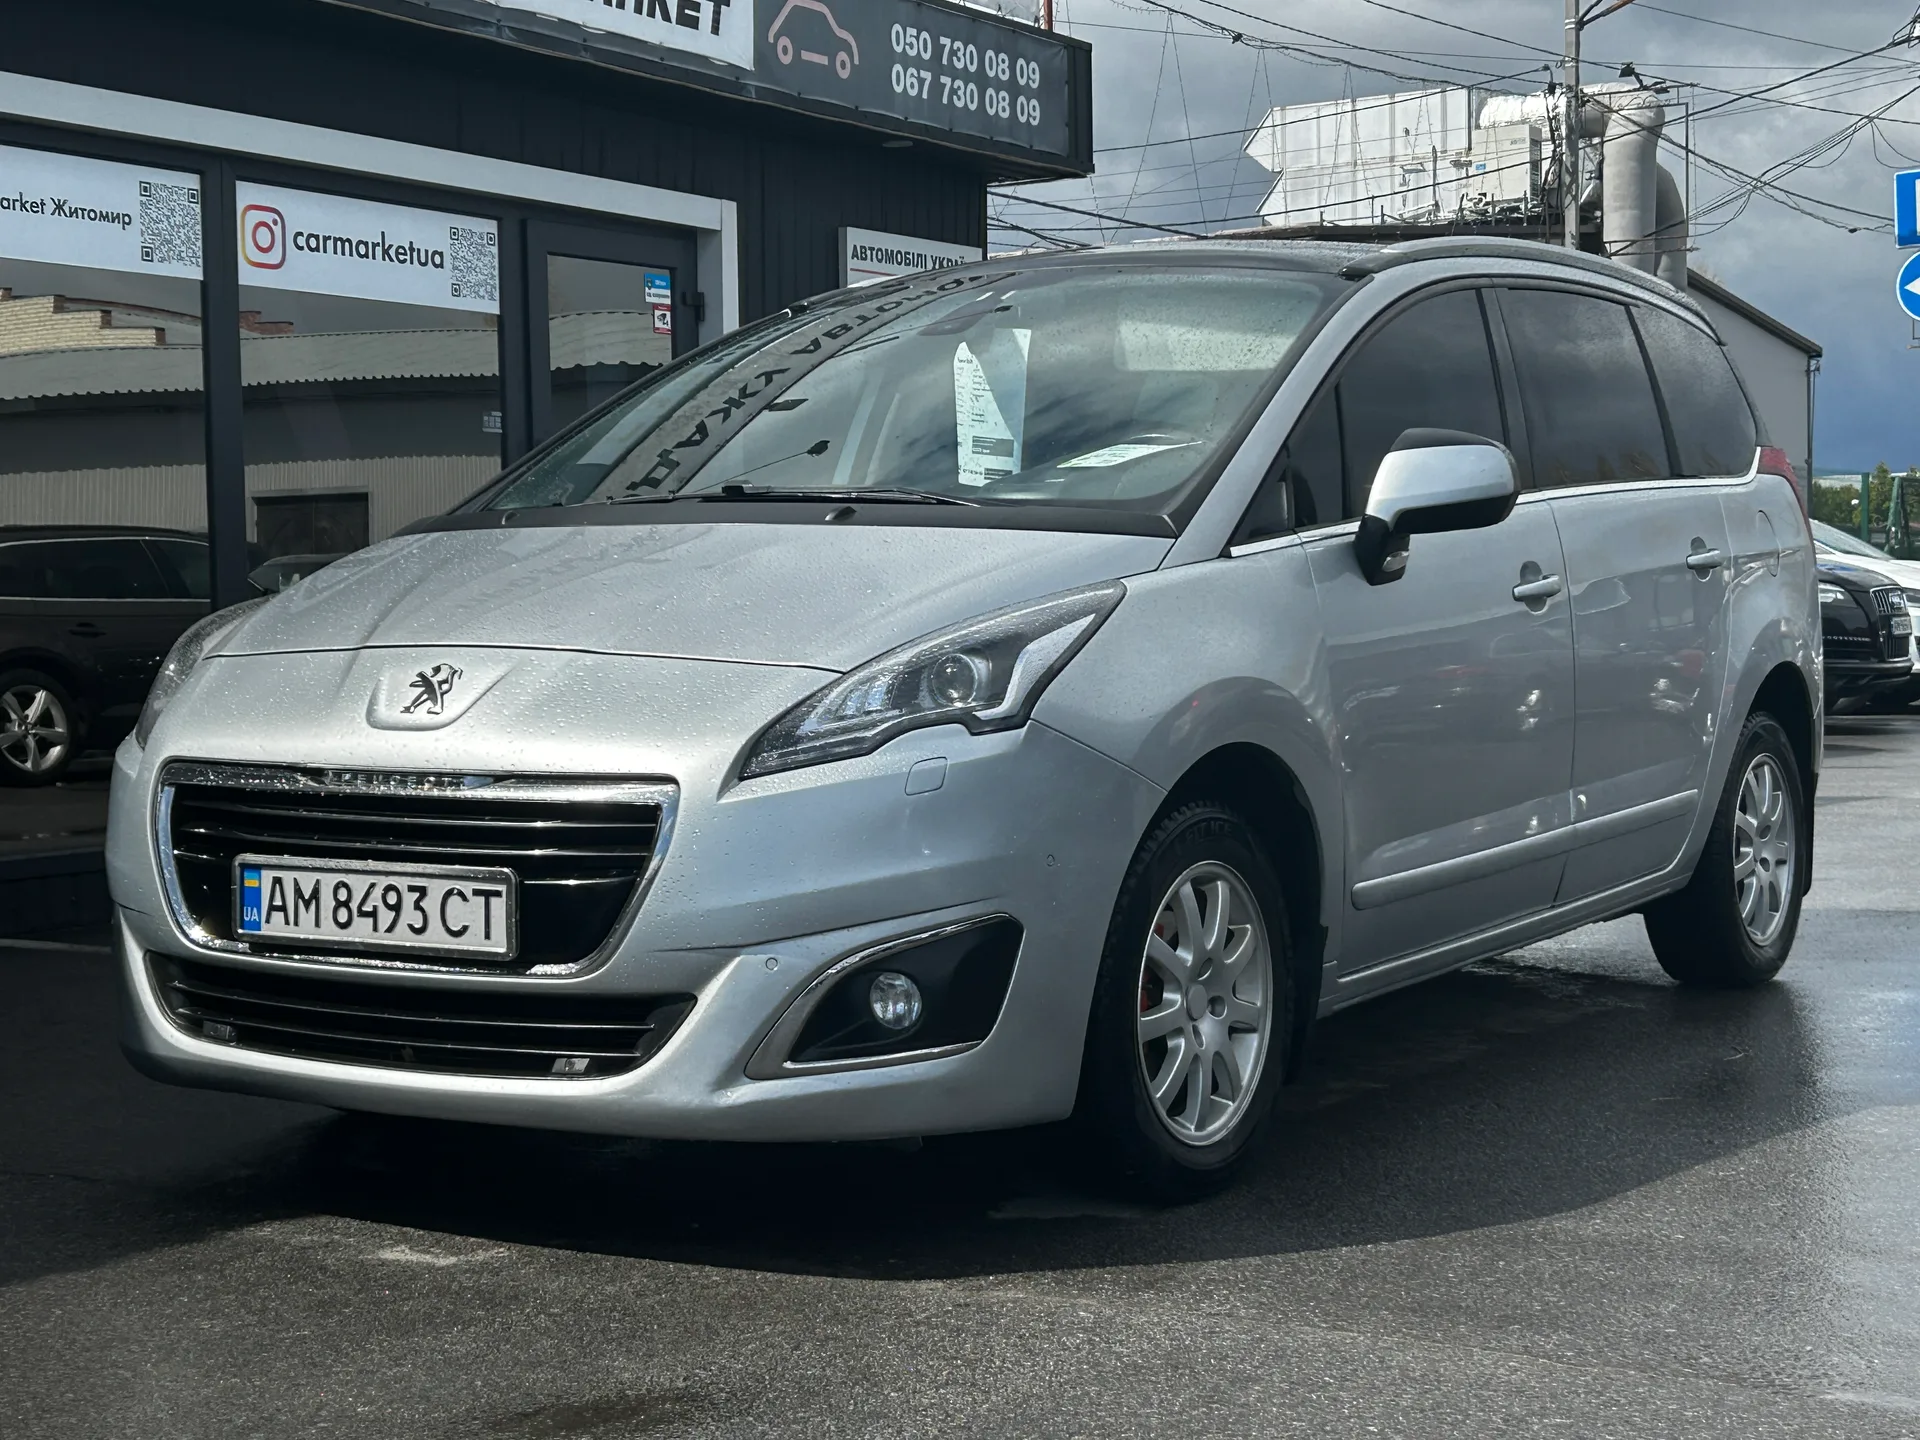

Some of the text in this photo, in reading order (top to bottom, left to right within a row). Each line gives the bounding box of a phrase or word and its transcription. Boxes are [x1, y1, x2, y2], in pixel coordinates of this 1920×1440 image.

[891, 23, 1040, 89] 050 730 08 09
[891, 63, 1041, 126] 067 730 08 09
[50, 197, 132, 231] Житомир
[292, 230, 445, 269] carmarketua
[851, 244, 928, 270] АВТОМОБІЛІ
[244, 876, 504, 941] UA AM 8493 CT
